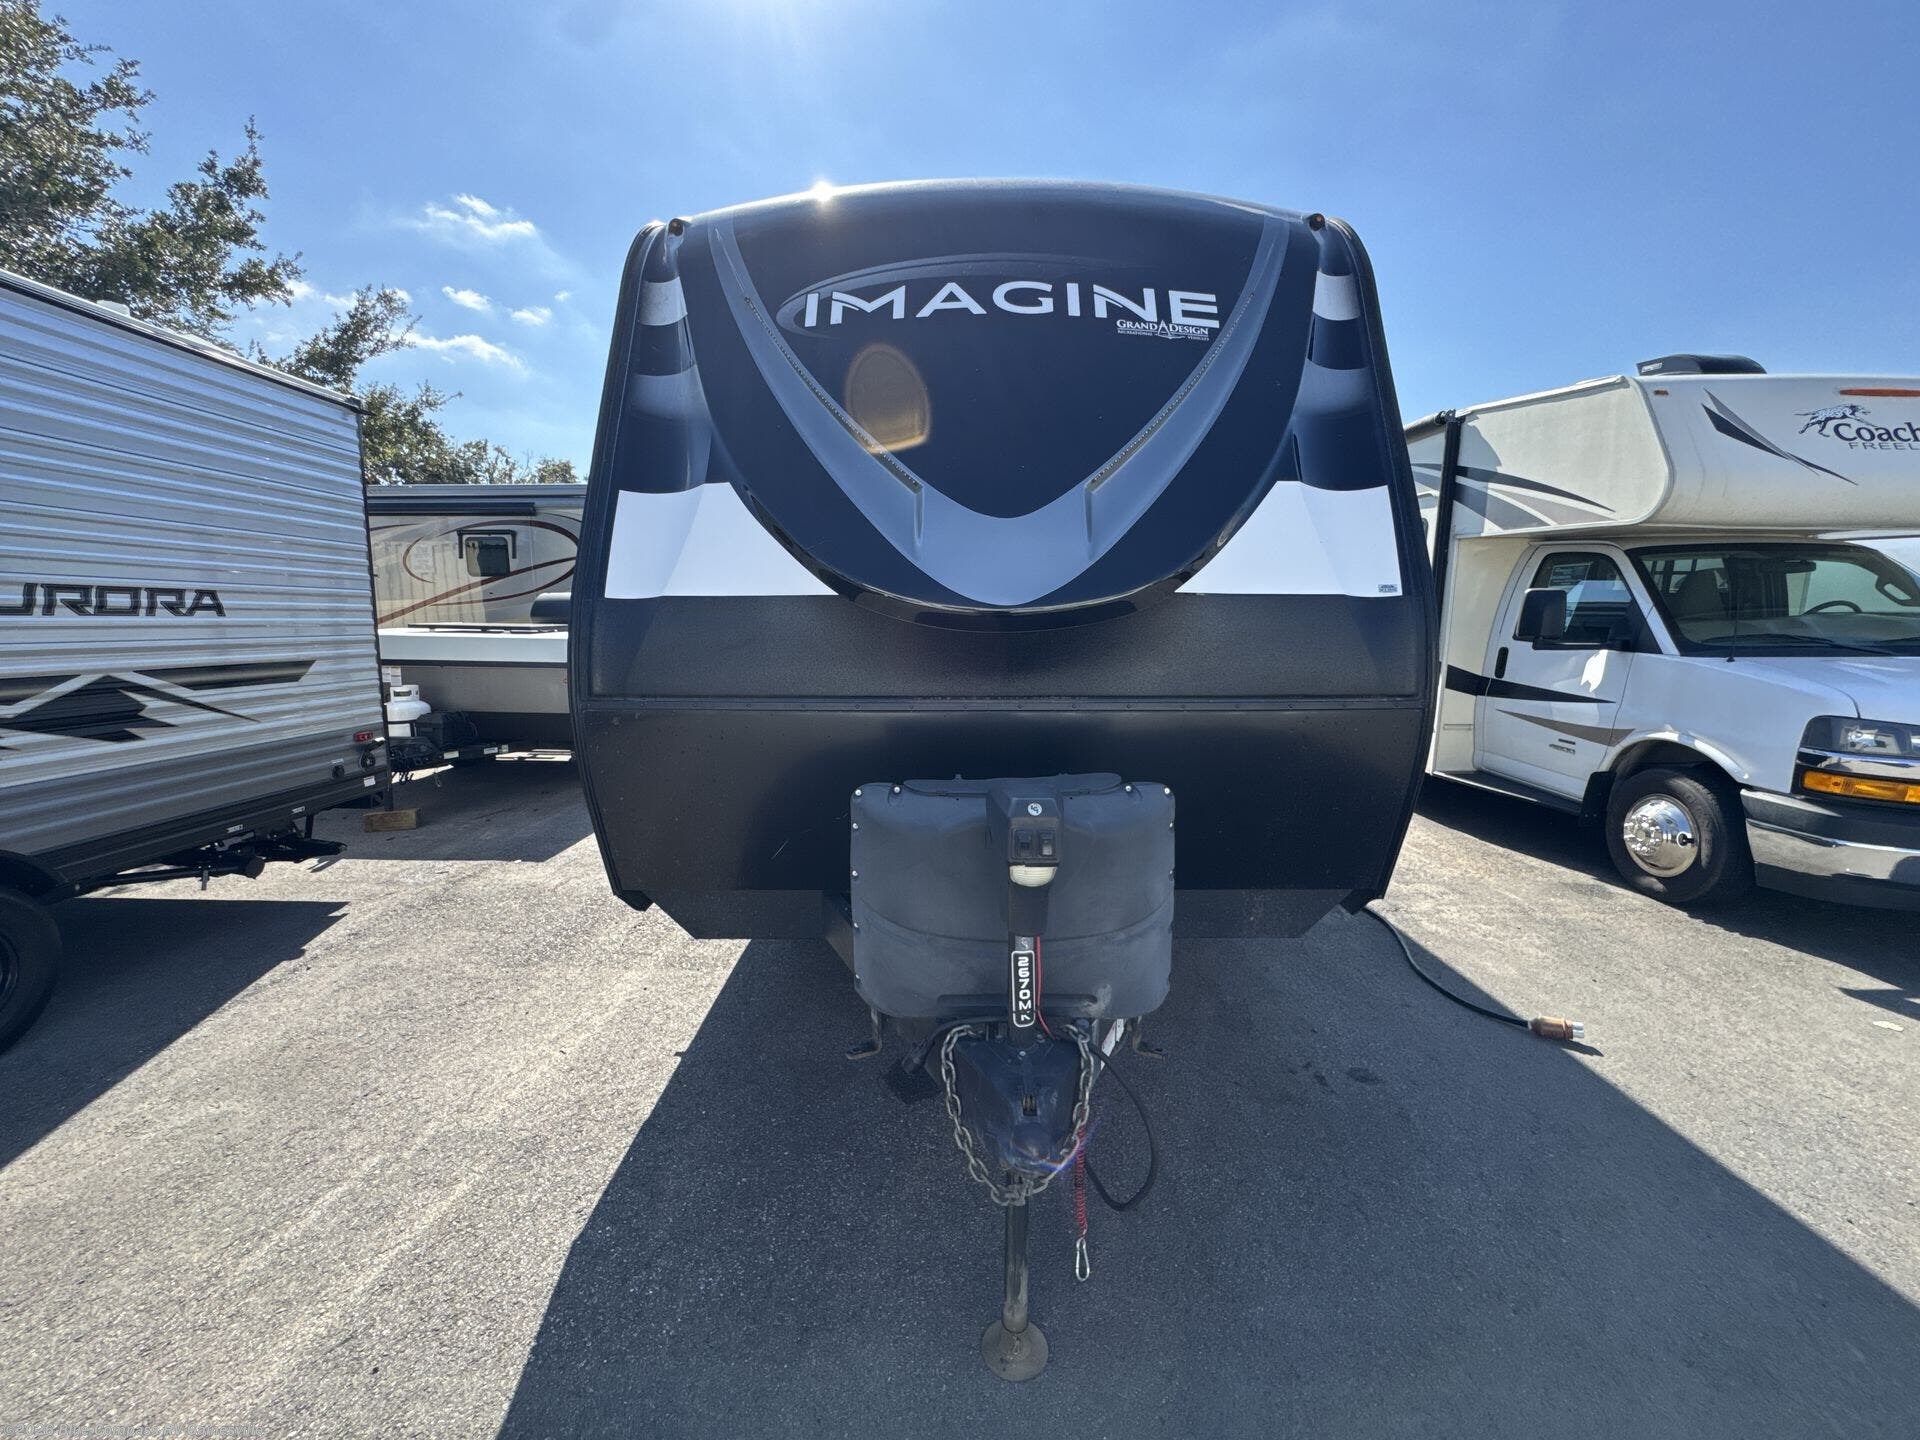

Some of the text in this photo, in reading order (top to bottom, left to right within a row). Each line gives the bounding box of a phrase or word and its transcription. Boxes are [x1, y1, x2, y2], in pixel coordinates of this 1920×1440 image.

[804, 280, 1220, 328] IMAGINE
[1116, 319, 1209, 335] GRAND DESIGN
